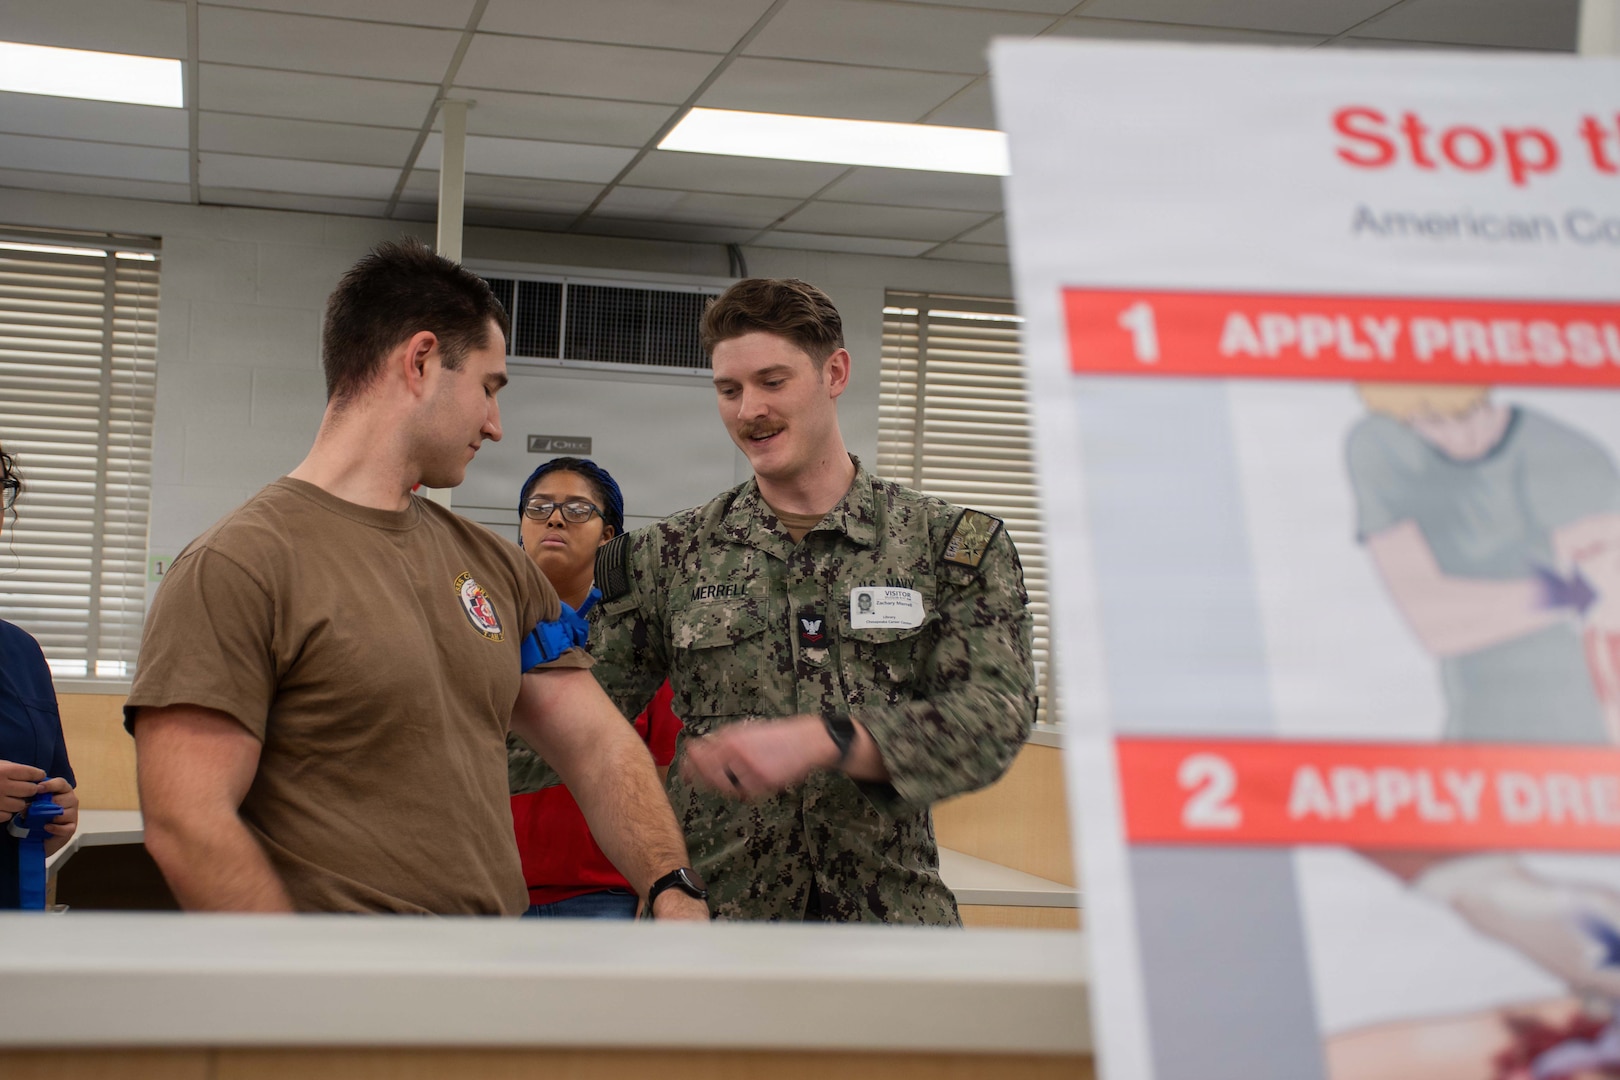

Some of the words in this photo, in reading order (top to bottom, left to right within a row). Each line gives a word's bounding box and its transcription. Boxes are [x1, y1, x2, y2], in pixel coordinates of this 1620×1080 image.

[1330, 104, 1561, 189] Stop
[1578, 110, 1620, 176] t
[1352, 202, 1558, 241] American
[1118, 301, 1160, 364] 1
[1219, 312, 1400, 362] APPLY
[156, 561, 164, 575] 1
[690, 584, 748, 602] MERRELL
[885, 590, 912, 598] VISITOR
[886, 578, 915, 589] NAVY
[1178, 754, 1242, 830] 2
[1287, 766, 1485, 823] APPLY
